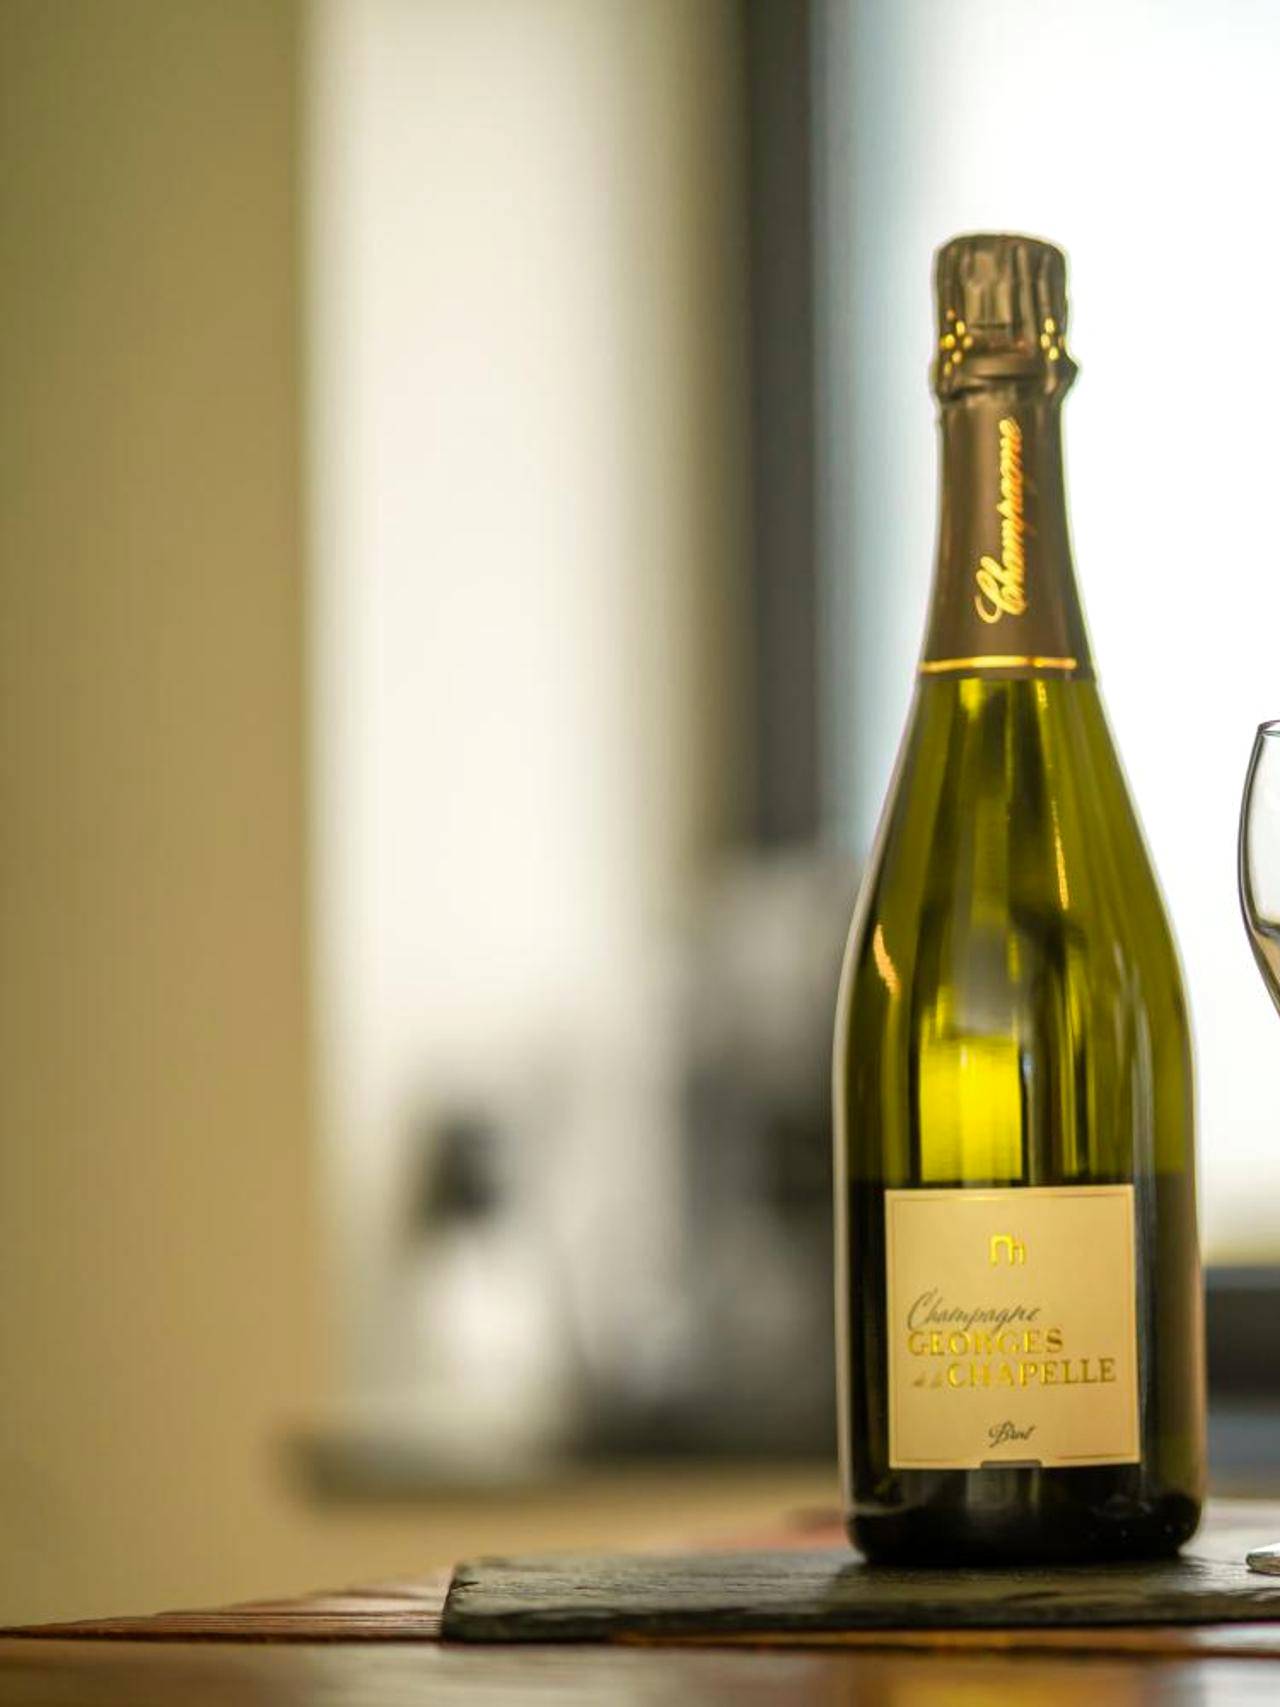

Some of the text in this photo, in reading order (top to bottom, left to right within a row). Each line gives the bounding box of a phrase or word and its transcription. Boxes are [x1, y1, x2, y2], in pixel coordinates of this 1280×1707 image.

[975, 418, 1034, 623] Champagne
[907, 1288, 1041, 1332] Champagne
[907, 1329, 1064, 1356] GEORGES
[947, 1358, 1117, 1388] CHAPELLE
[987, 1420, 1036, 1448] Brut
